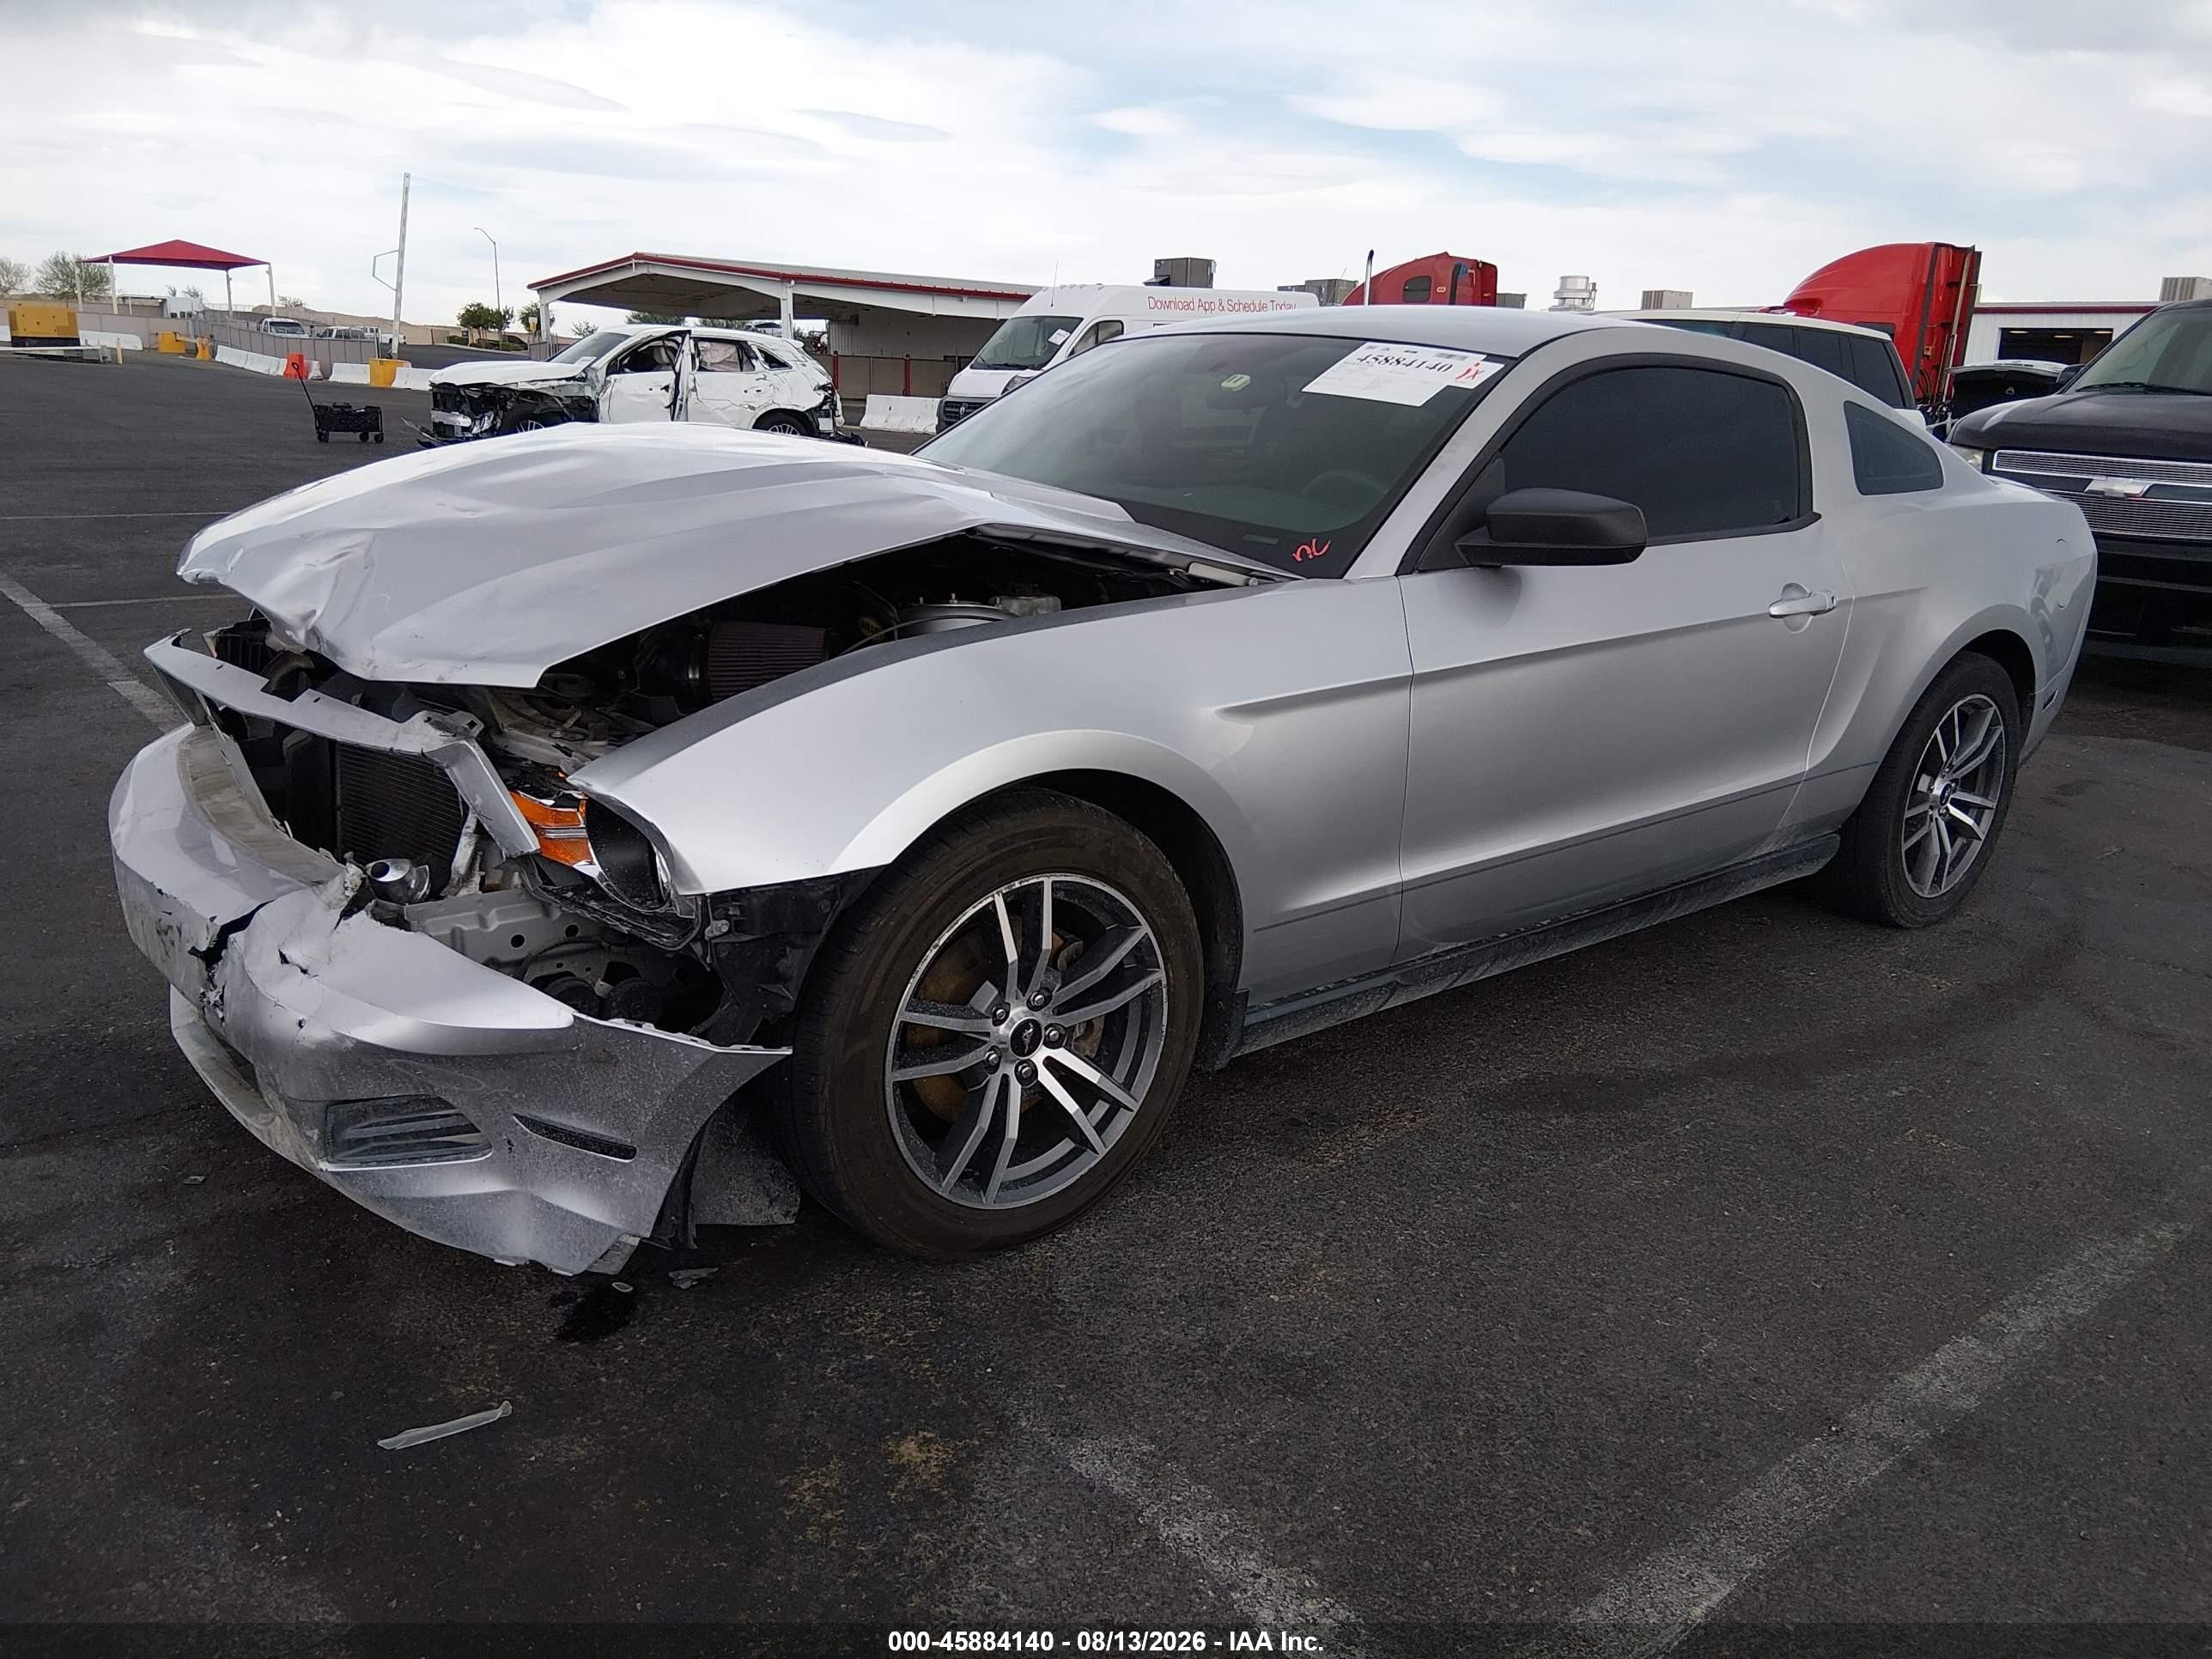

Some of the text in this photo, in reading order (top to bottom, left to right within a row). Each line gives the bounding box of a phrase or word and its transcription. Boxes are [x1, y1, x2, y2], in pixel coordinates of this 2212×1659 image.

[1147, 295, 1195, 311] Download
[1197, 298, 1216, 314] App
[1218, 298, 1225, 312] &
[1226, 298, 1267, 313] Schedule
[1356, 354, 1454, 372] 45884140
